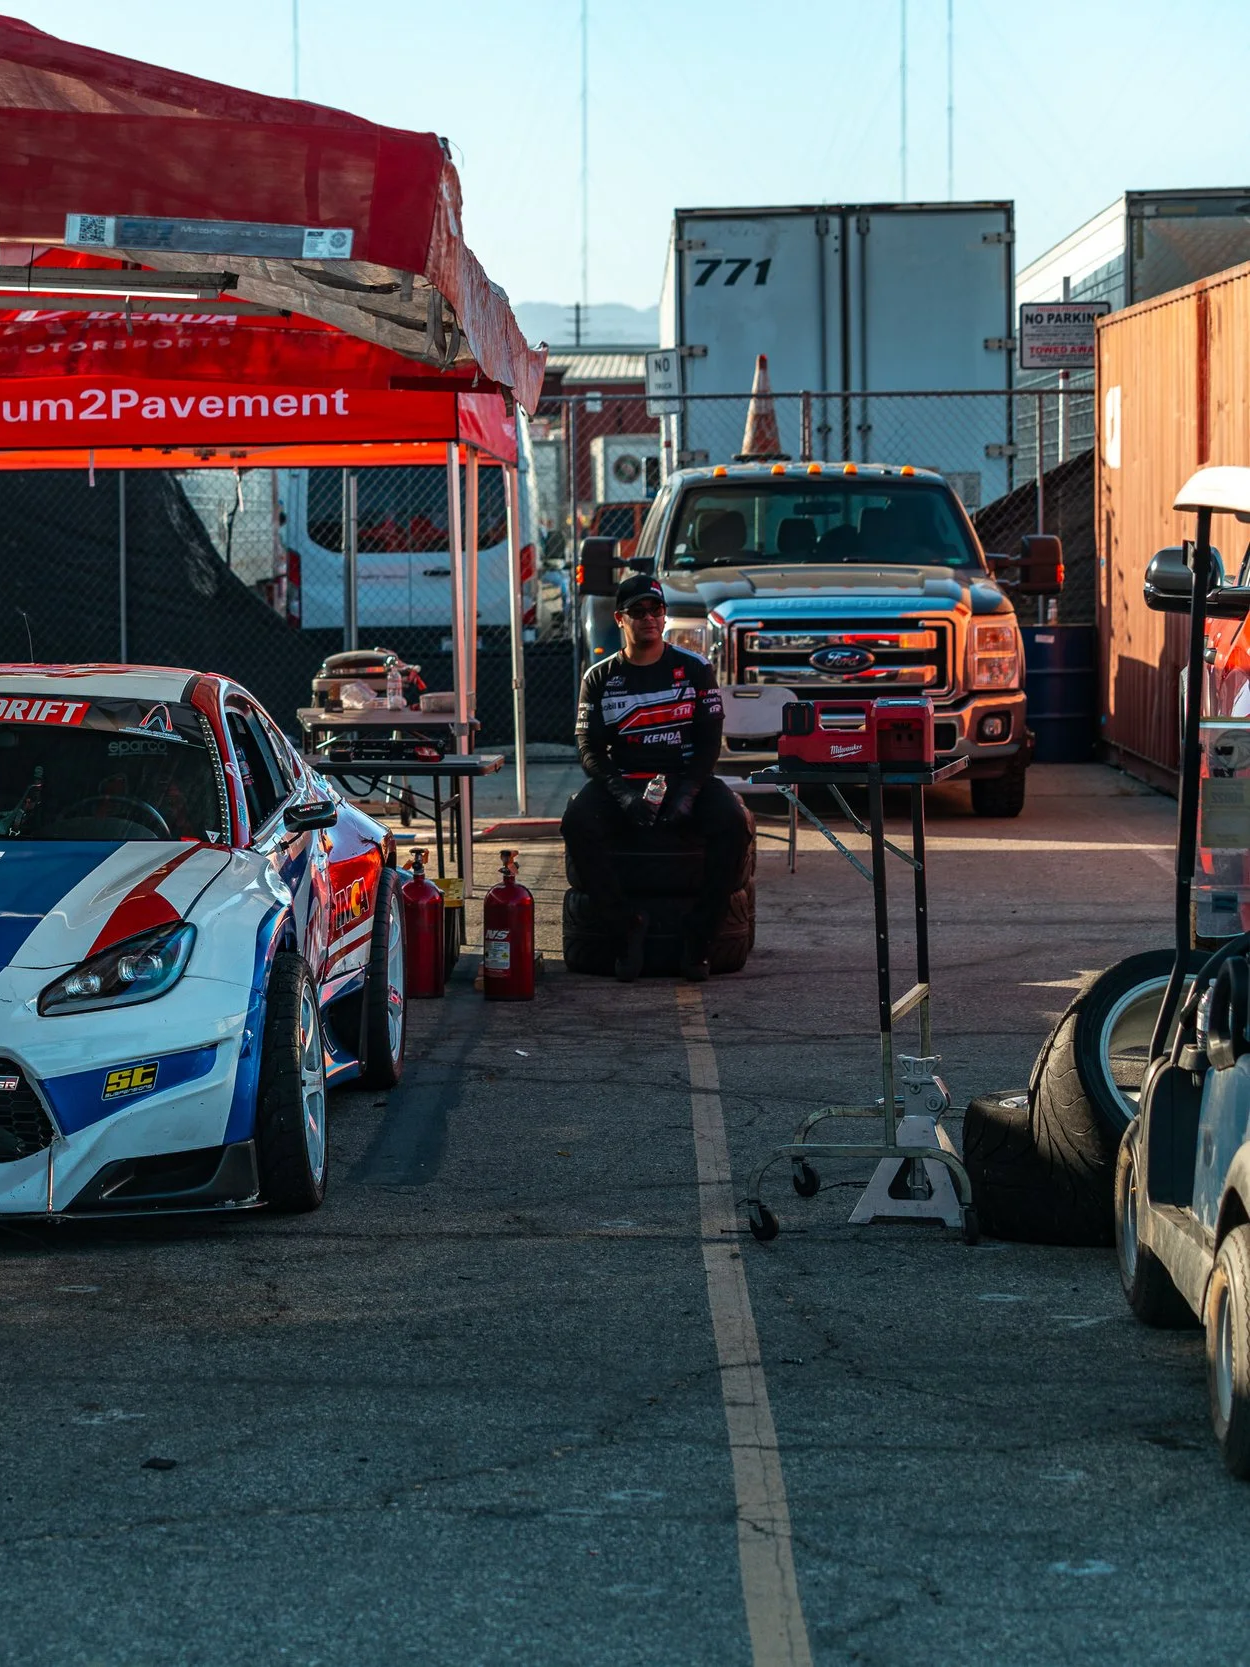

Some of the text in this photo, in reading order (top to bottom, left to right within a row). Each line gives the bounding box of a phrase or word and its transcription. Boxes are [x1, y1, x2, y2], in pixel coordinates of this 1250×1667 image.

[694, 258, 772, 287] 771
[1025, 315, 1044, 325] NO
[1070, 346, 1095, 354] AWA
[654, 357, 671, 372] NO
[643, 730, 682, 744] KENDA
